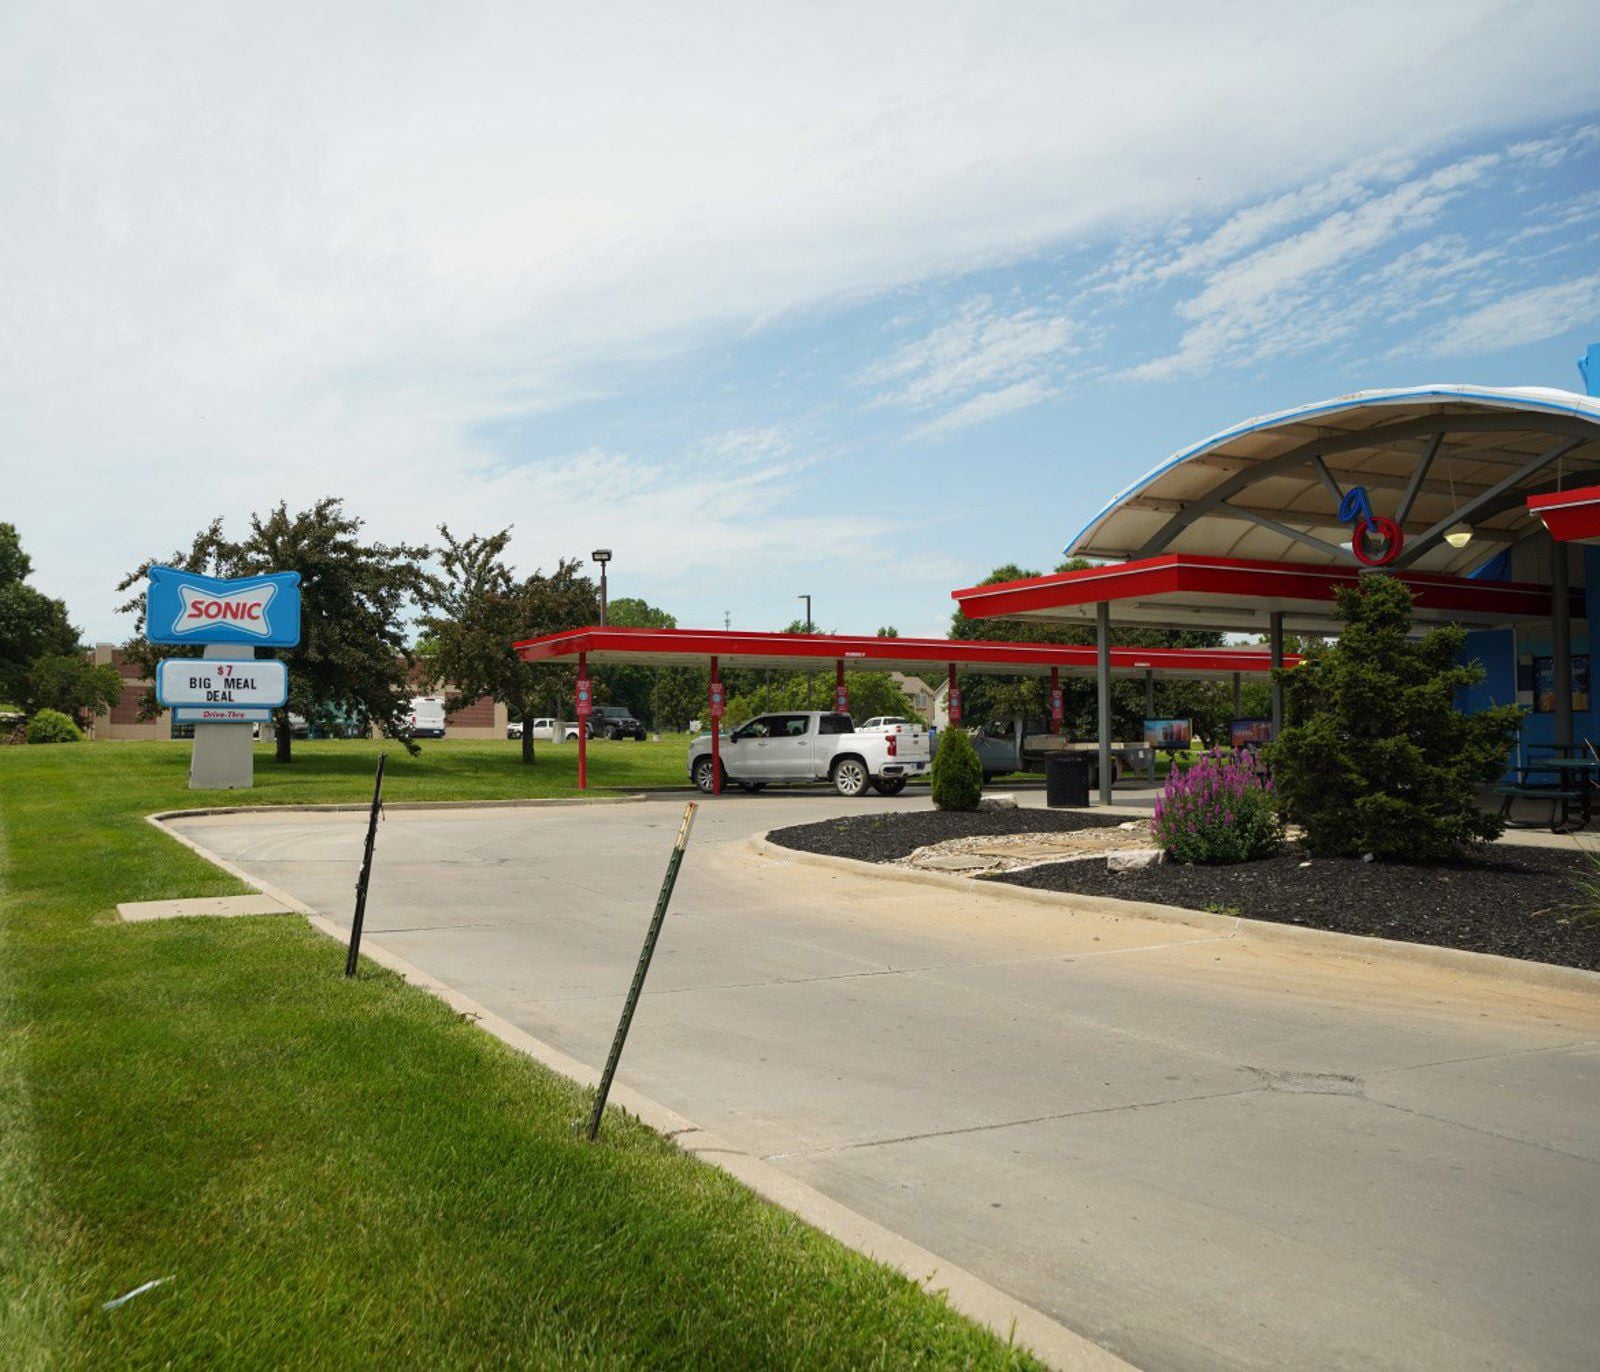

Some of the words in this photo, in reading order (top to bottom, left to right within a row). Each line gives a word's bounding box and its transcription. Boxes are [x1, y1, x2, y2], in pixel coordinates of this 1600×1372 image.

[187, 600, 262, 620] SONIC
[217, 665, 233, 676] $7
[189, 677, 211, 689] BIG
[224, 678, 257, 690] MEAL
[206, 690, 234, 702] DEAL
